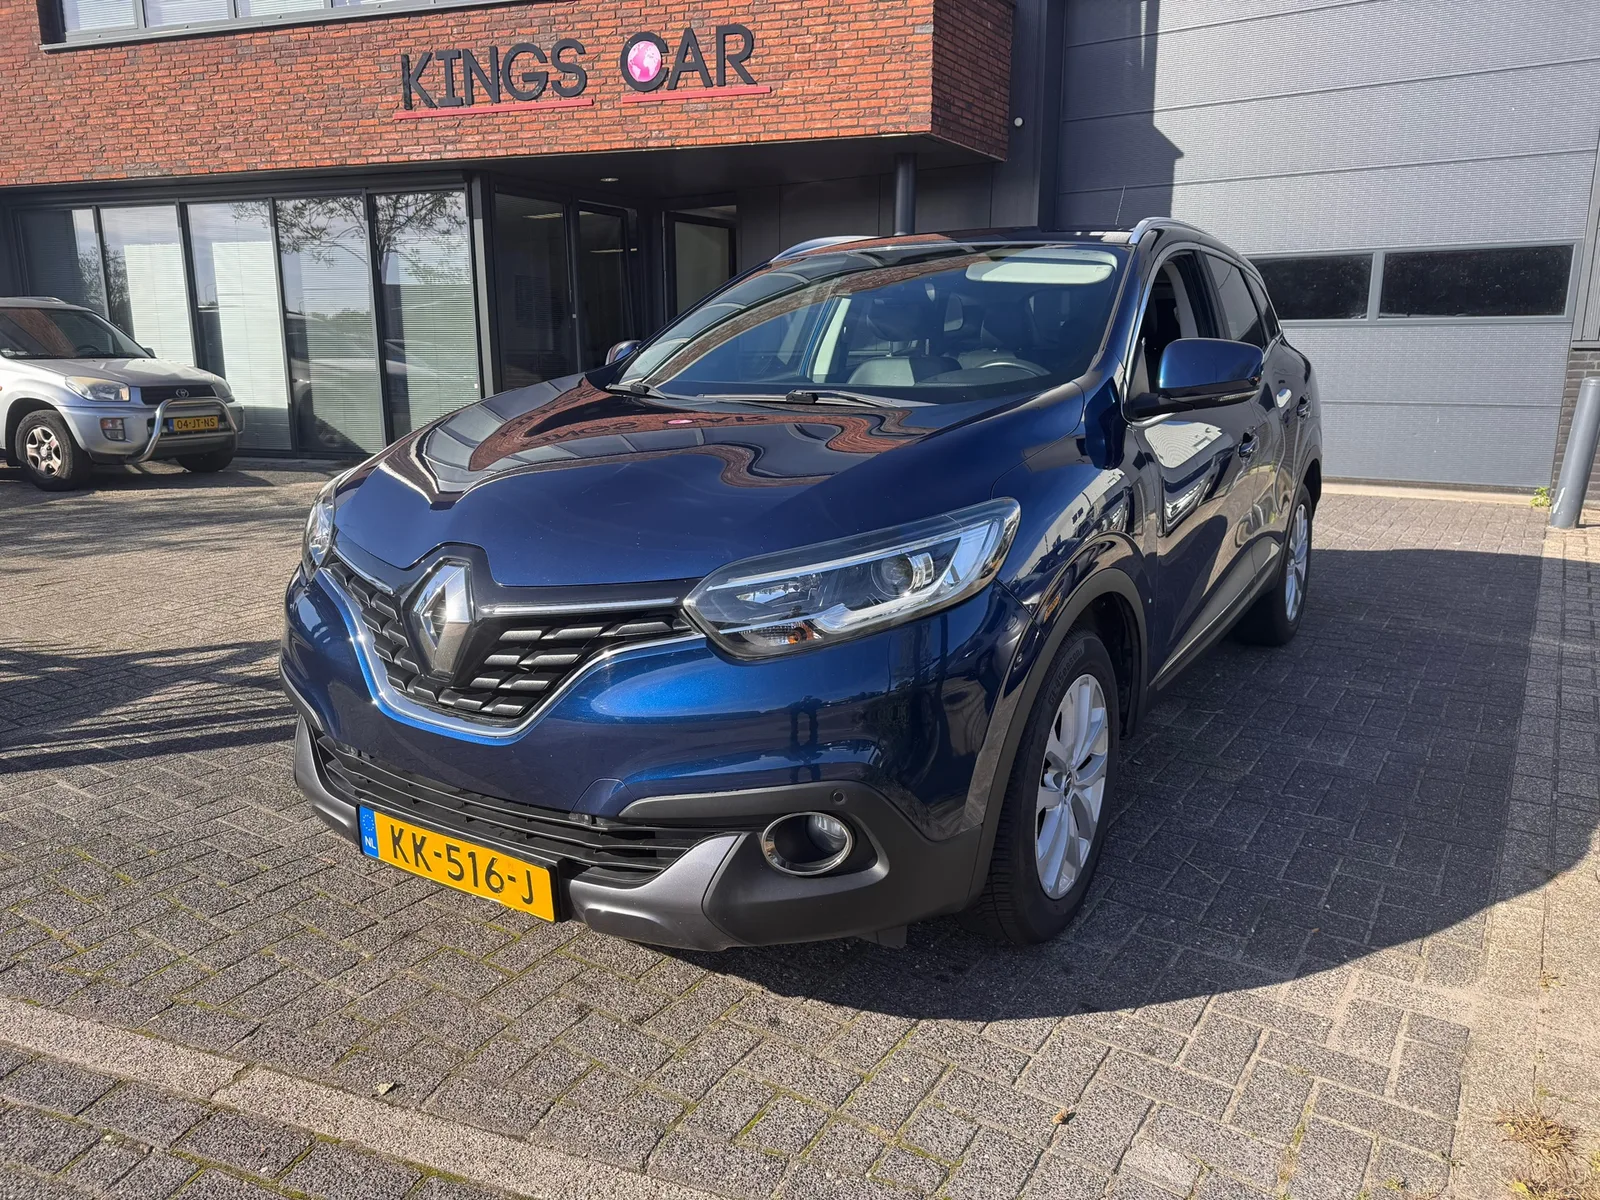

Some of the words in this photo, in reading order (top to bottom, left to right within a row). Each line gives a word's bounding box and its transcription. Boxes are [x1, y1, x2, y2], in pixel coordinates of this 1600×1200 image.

[400, 37, 587, 110] KINGS
[620, 23, 758, 92] CAR
[176, 418, 215, 429] 04-JT-NS
[365, 835, 377, 849] NL
[390, 824, 534, 904] KK-516-J
